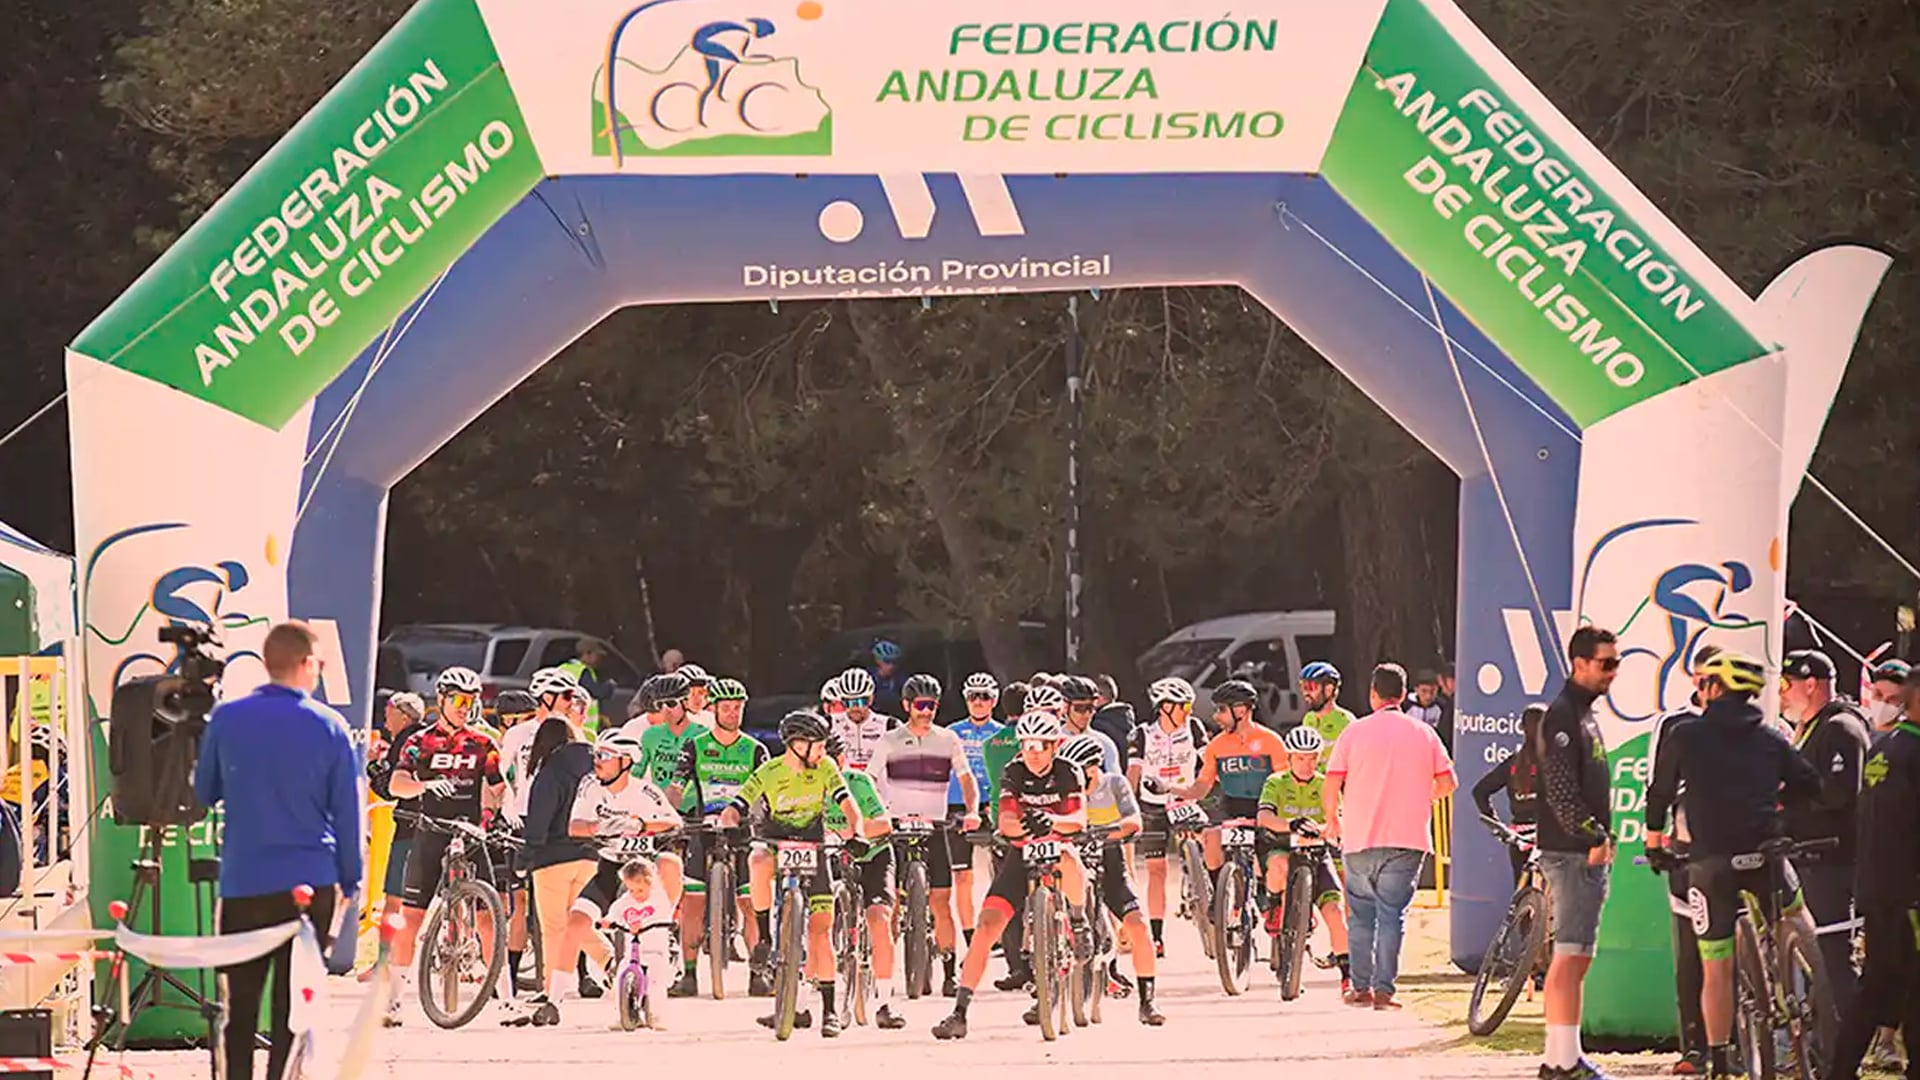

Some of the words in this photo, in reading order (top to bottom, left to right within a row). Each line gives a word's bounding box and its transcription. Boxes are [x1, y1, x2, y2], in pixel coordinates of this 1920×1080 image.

[949, 13, 1278, 56] FEDERACIÓN
[875, 68, 1159, 102] ANDALUZA
[962, 115, 1030, 140] DE
[1045, 111, 1285, 140] CICLISMO
[209, 59, 448, 303] FEDERACIÓN
[1373, 71, 1588, 277] ANDALUZA
[1458, 89, 1705, 322] FEDERACIÓN
[278, 289, 342, 357] DE
[339, 120, 514, 298] CICLISMO
[194, 175, 402, 387] ANDALUZA
[743, 260, 931, 291] Diputación
[942, 254, 1110, 282] Provincial
[1403, 155, 1473, 220] DE
[1463, 214, 1646, 388] CICLISMO
[430, 753, 477, 770] BH
[621, 837, 649, 852] 228
[1028, 842, 1056, 859] 201
[1230, 829, 1247, 844] 23
[783, 851, 812, 866] 204
